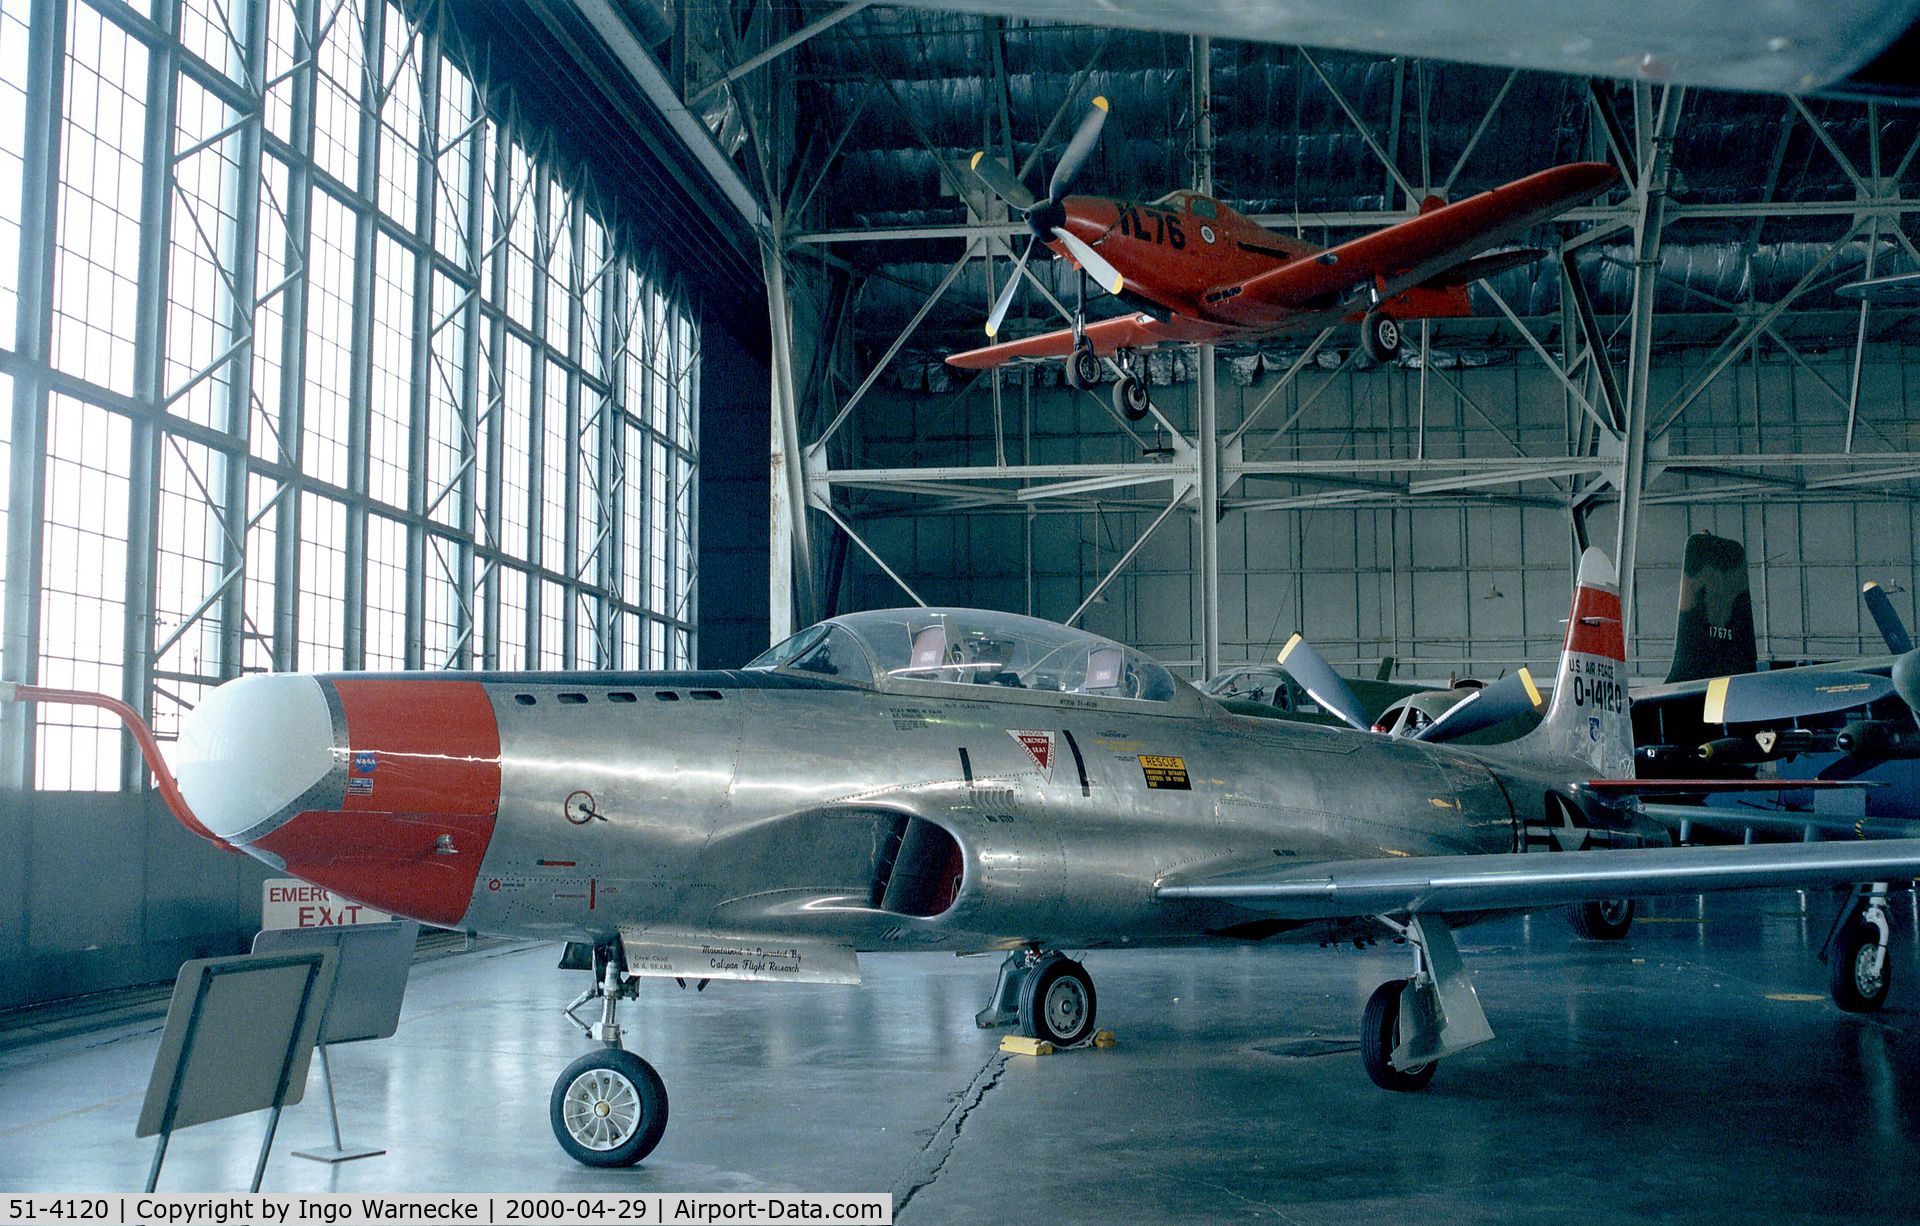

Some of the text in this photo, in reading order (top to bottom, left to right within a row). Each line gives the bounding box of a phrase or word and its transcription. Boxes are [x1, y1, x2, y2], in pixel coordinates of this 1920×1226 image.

[1585, 661, 1596, 676] AIR
[1597, 663, 1614, 680] FORCE
[1018, 740, 1042, 768] DANGER
[1047, 741, 1055, 768] DANGER
[1145, 756, 1179, 768] RESCUE
[701, 944, 743, 956] Maintained
[756, 947, 788, 960] Operated
[790, 949, 802, 963] By
[742, 959, 766, 974] Flight
[769, 961, 800, 973] Research
